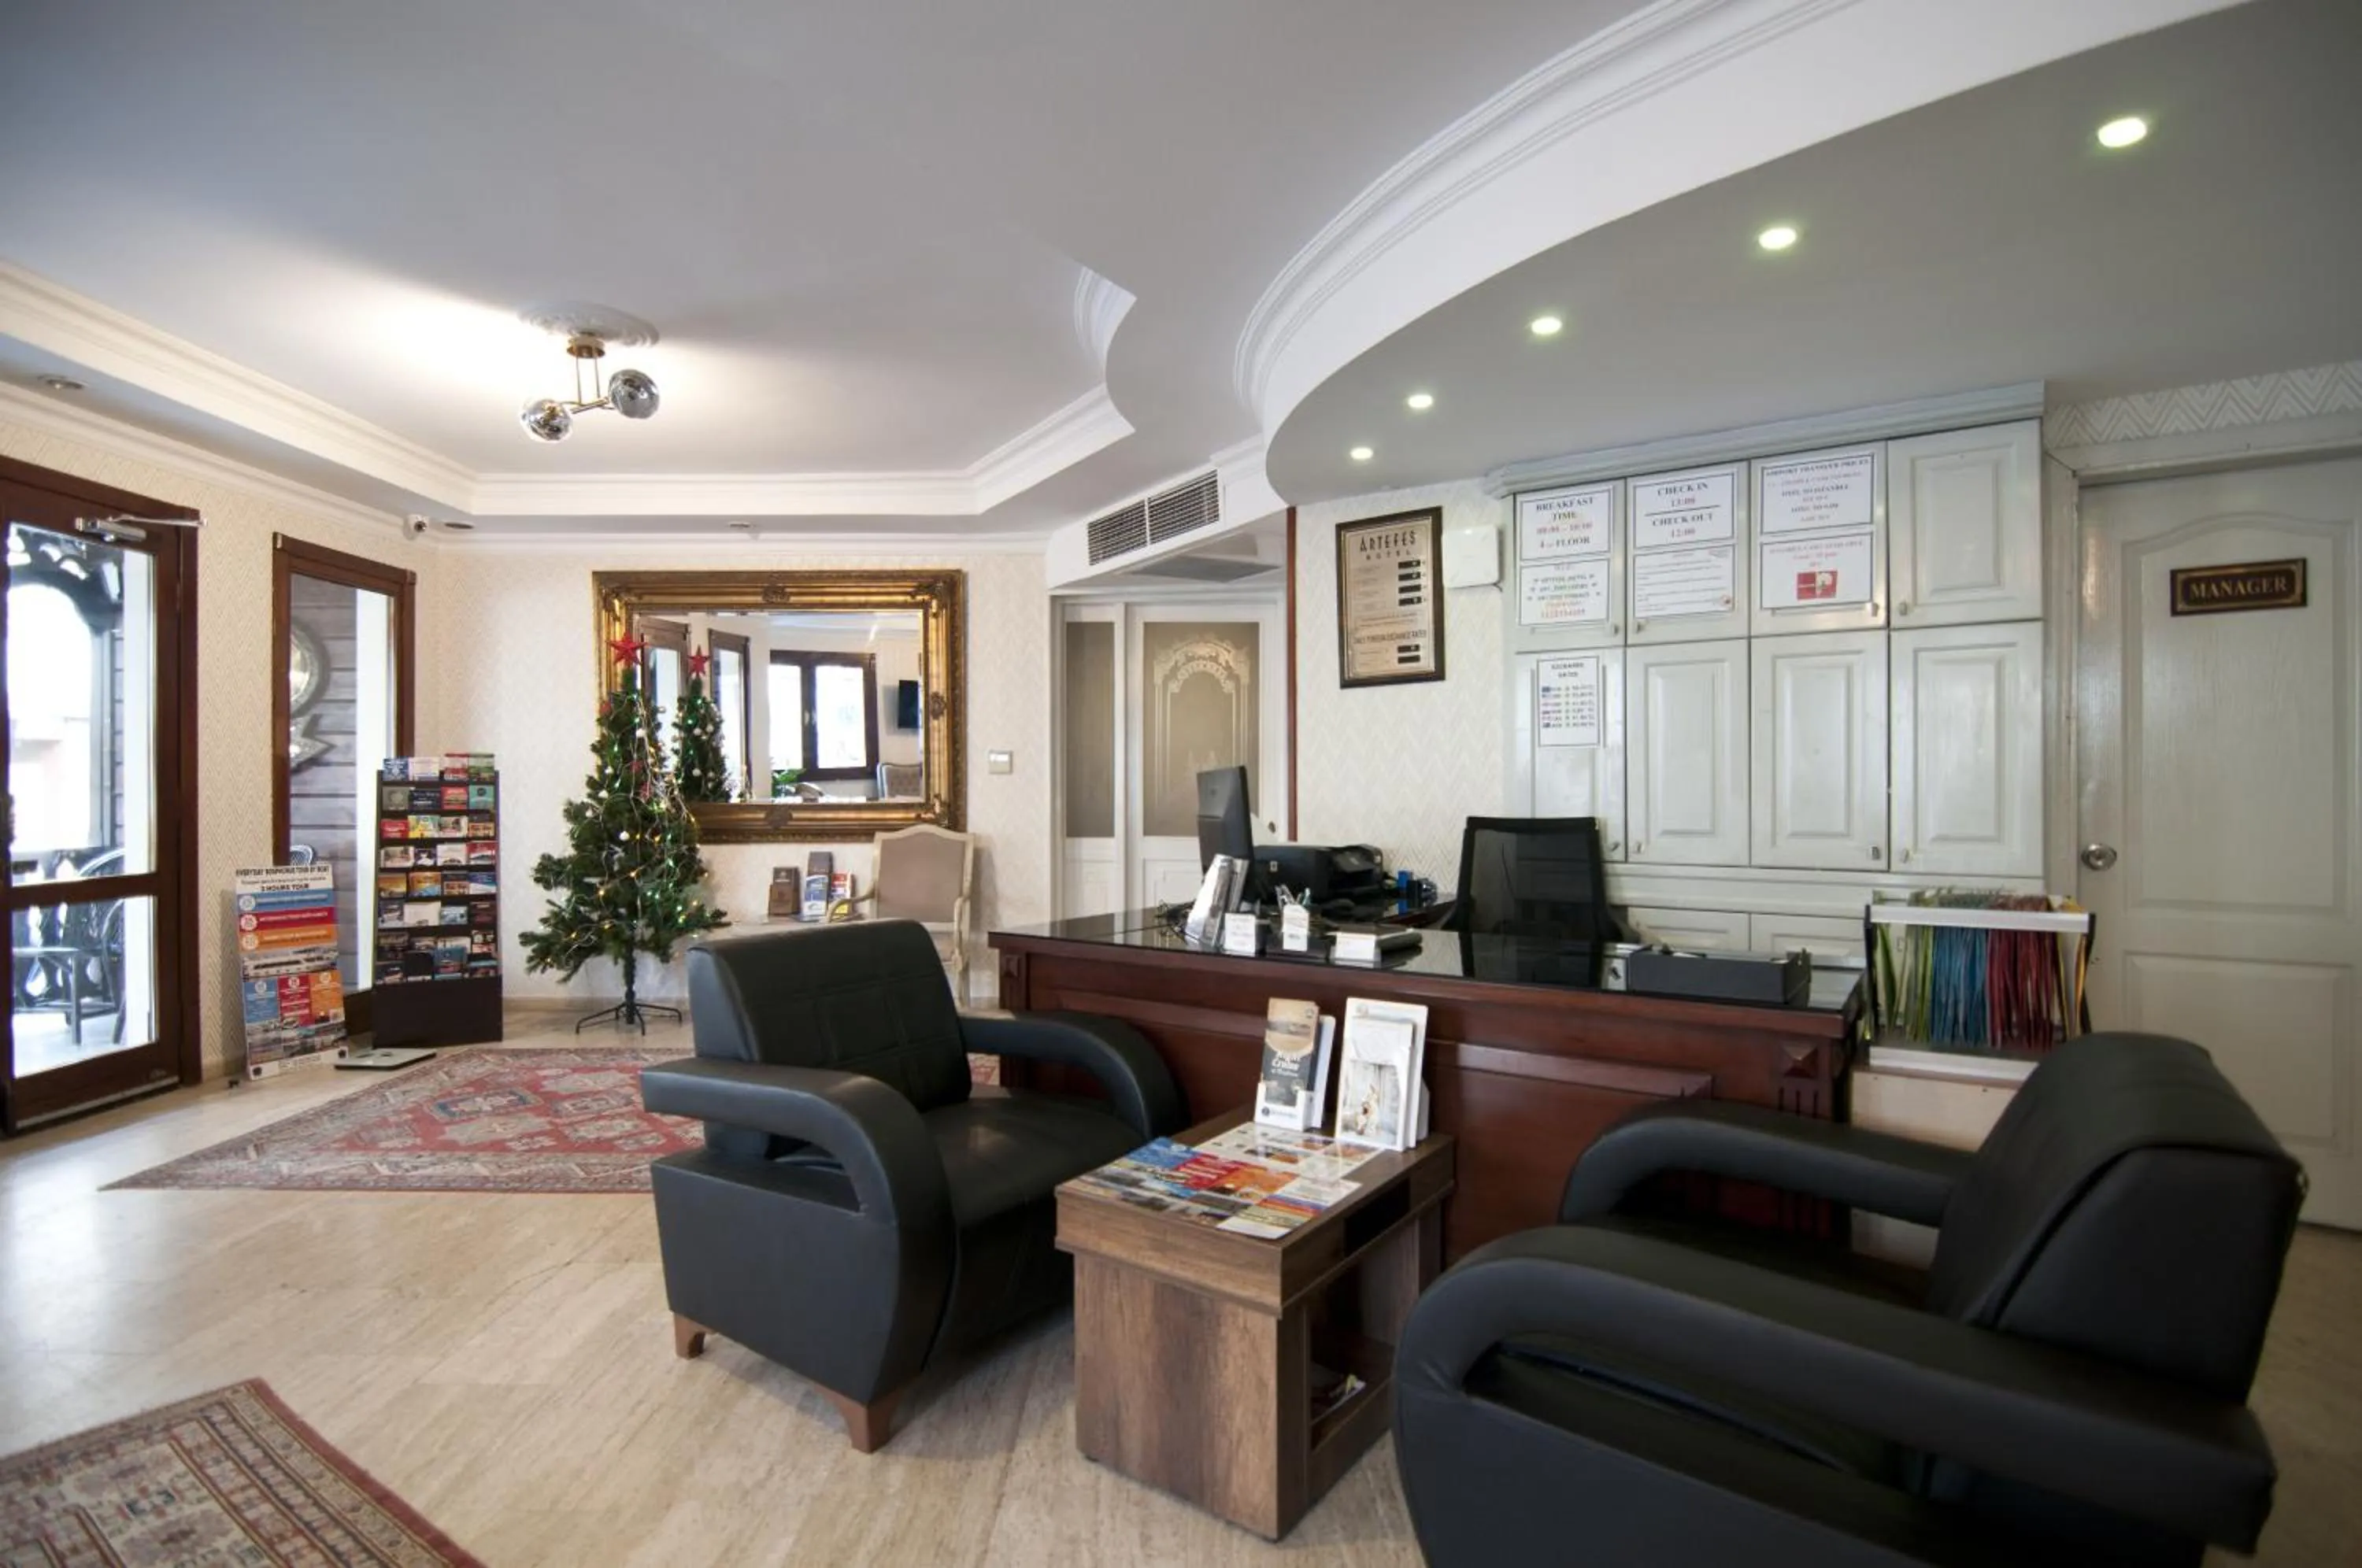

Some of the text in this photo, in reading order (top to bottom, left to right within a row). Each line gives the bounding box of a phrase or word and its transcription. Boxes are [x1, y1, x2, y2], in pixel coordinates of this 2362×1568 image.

[1657, 482, 1709, 496] CHECK IN
[1535, 497, 1594, 511] BREAKFAST
[1553, 511, 1578, 521] TIME
[1652, 512, 1713, 527] CHECK OUT
[1360, 530, 1416, 553] ARTEFES
[1556, 536, 1590, 549] FLOOR
[2190, 575, 2287, 598] MANAGER
